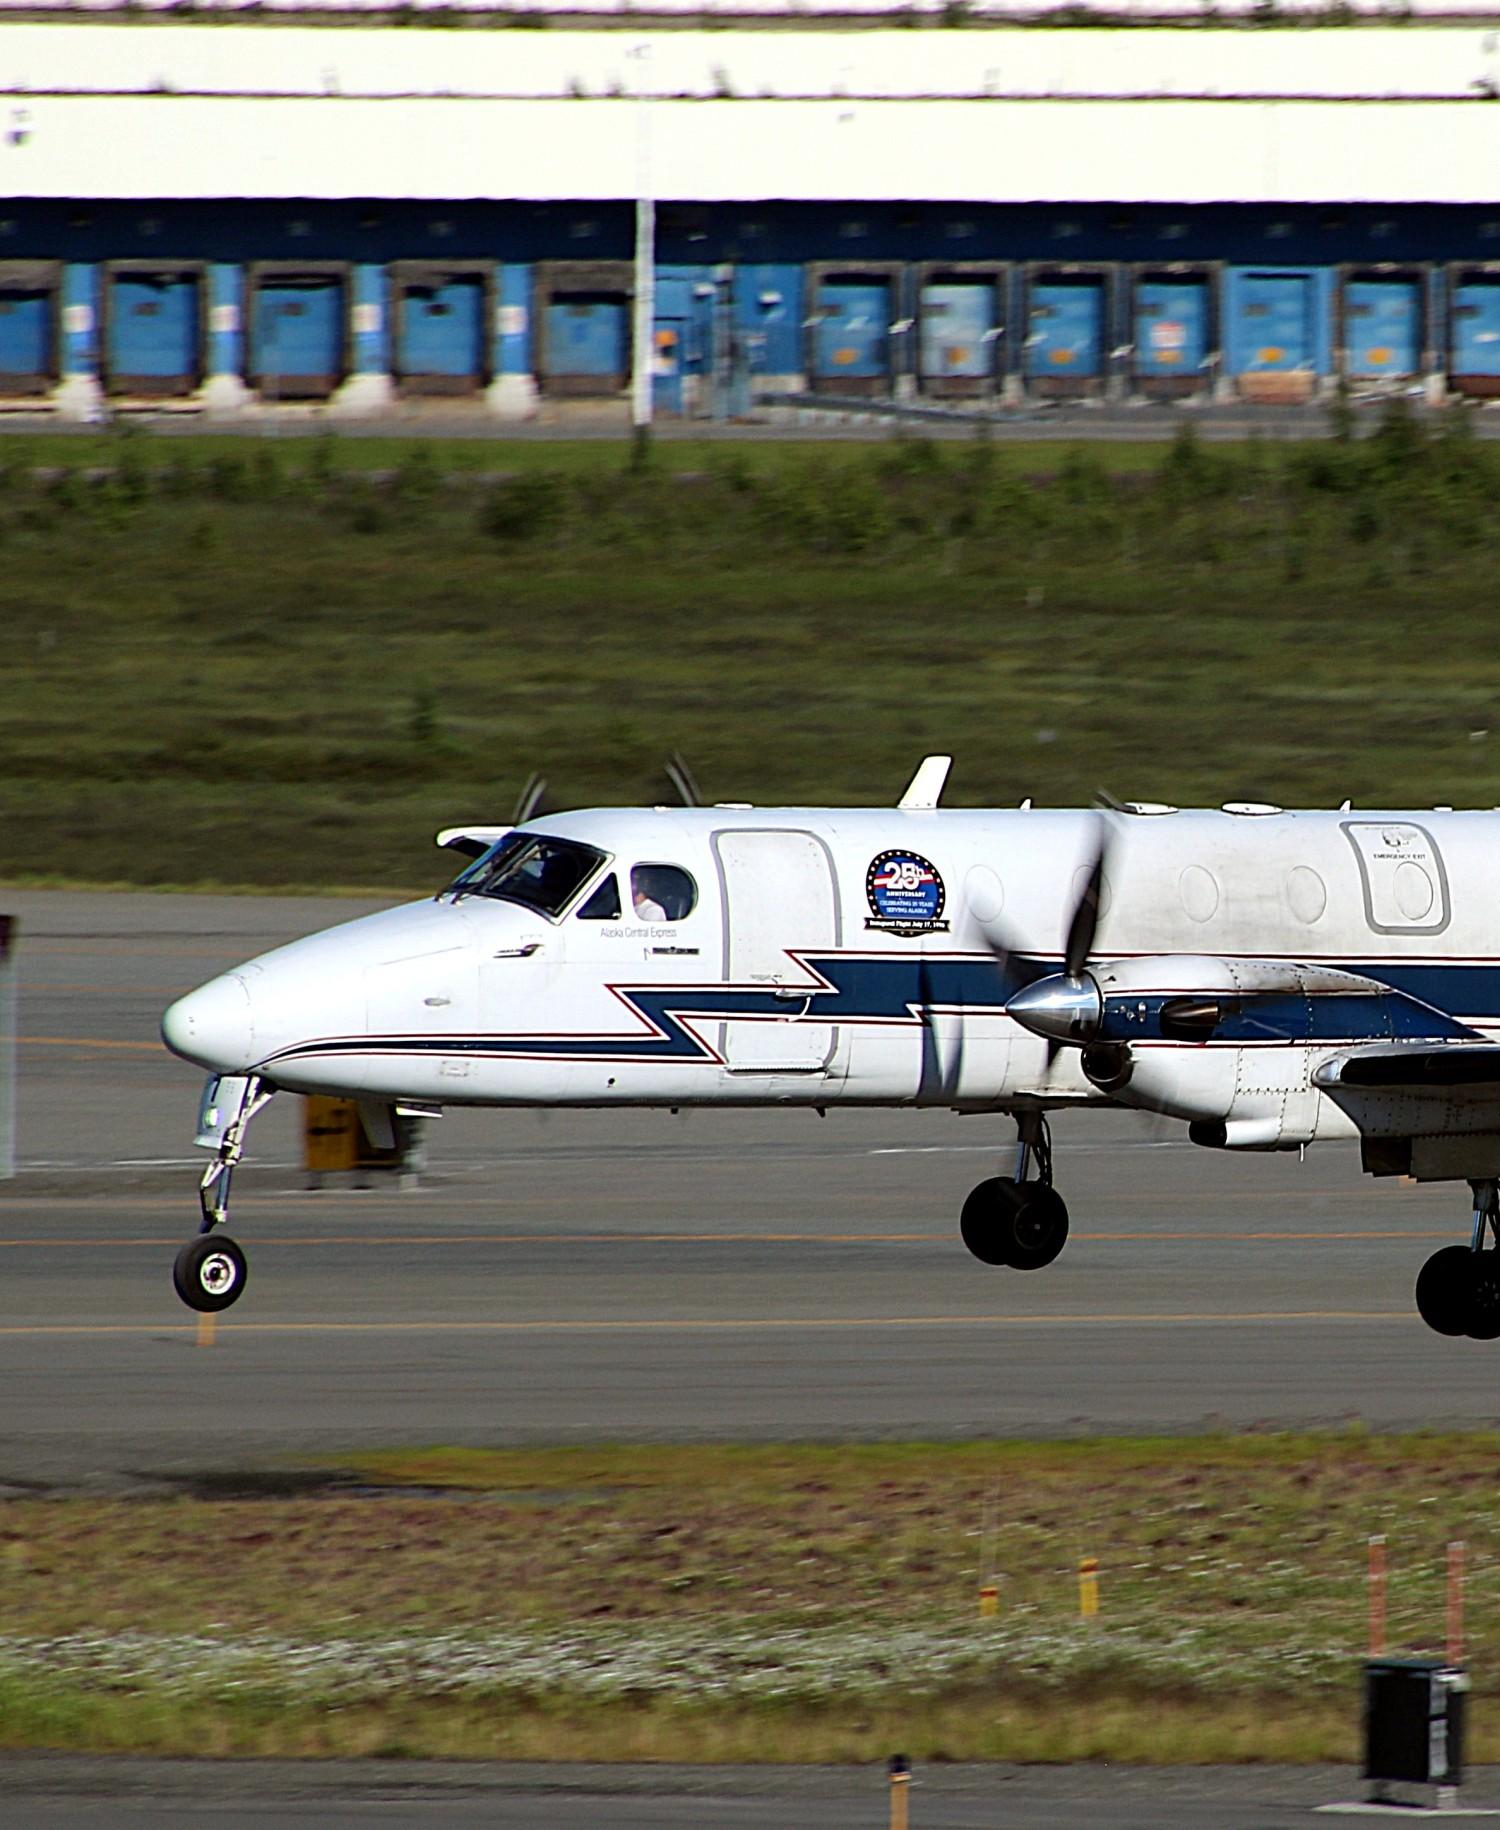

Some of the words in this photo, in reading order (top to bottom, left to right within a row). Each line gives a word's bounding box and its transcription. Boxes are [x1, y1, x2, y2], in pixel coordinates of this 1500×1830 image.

[884, 861, 925, 890] 25th
[600, 927, 624, 938] Alaska
[625, 927, 649, 938] Central
[650, 927, 677, 939] Express
